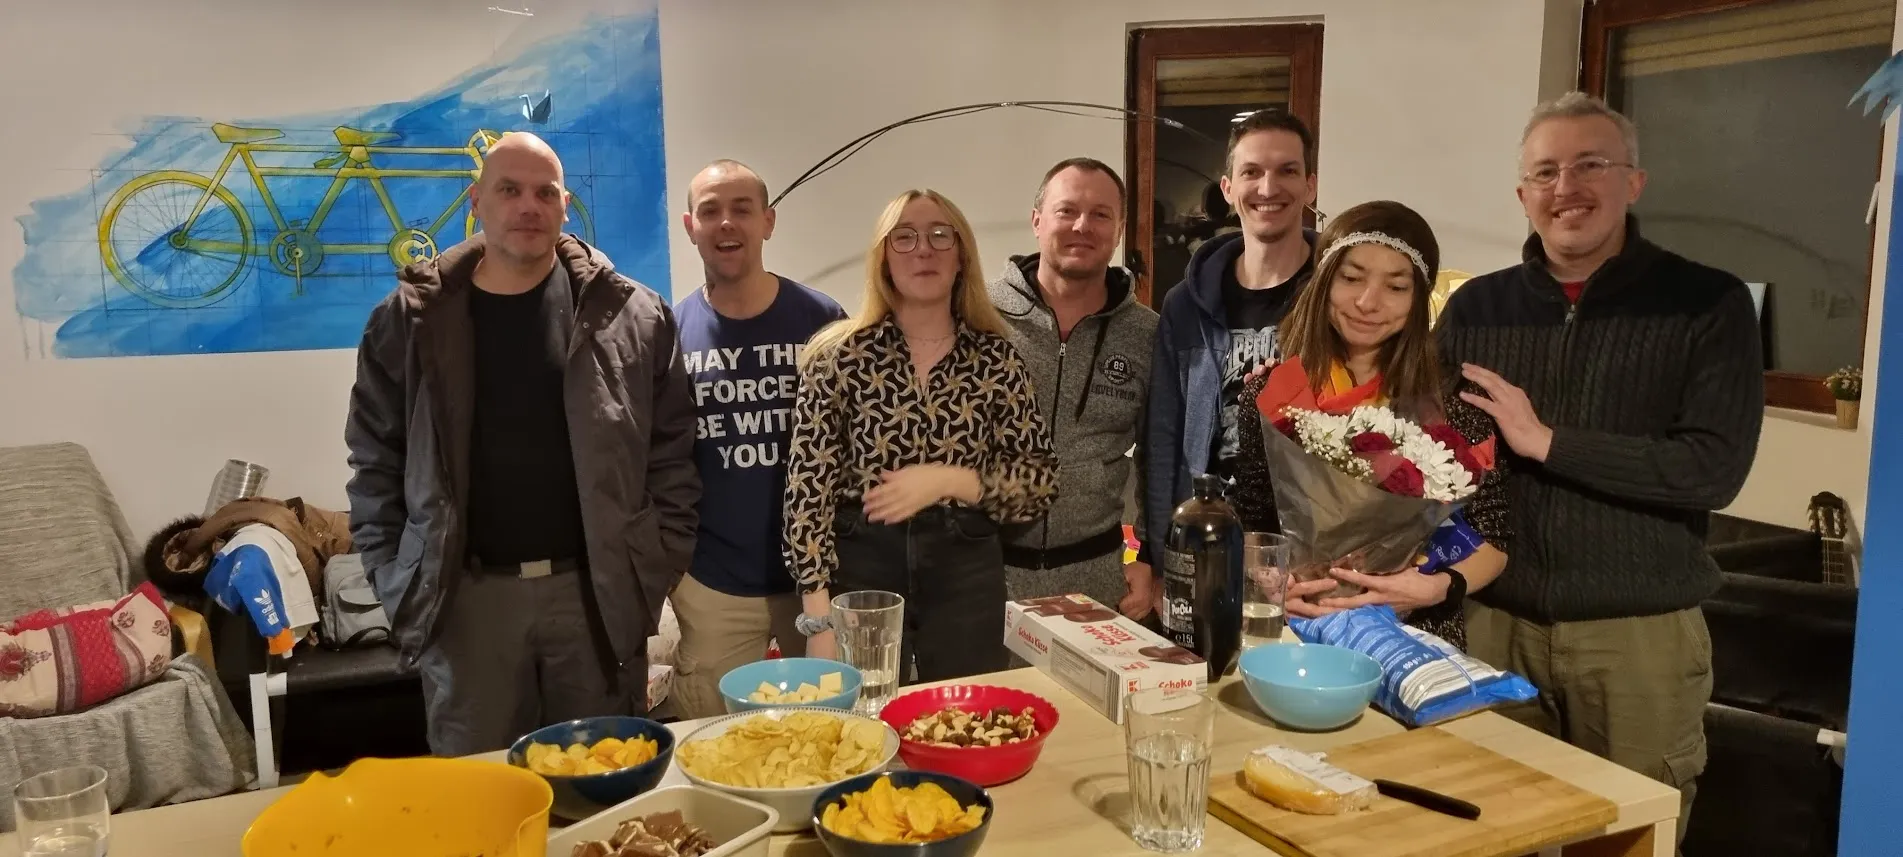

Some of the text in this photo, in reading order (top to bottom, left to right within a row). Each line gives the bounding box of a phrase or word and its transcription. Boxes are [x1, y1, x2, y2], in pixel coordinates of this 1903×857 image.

[682, 347, 743, 375] MAY
[1113, 360, 1125, 372] 89
[695, 375, 796, 406] FORCE
[695, 408, 797, 440] BE WIT
[1018, 626, 1034, 644] Schoko
[1158, 678, 1193, 690] Schoko
